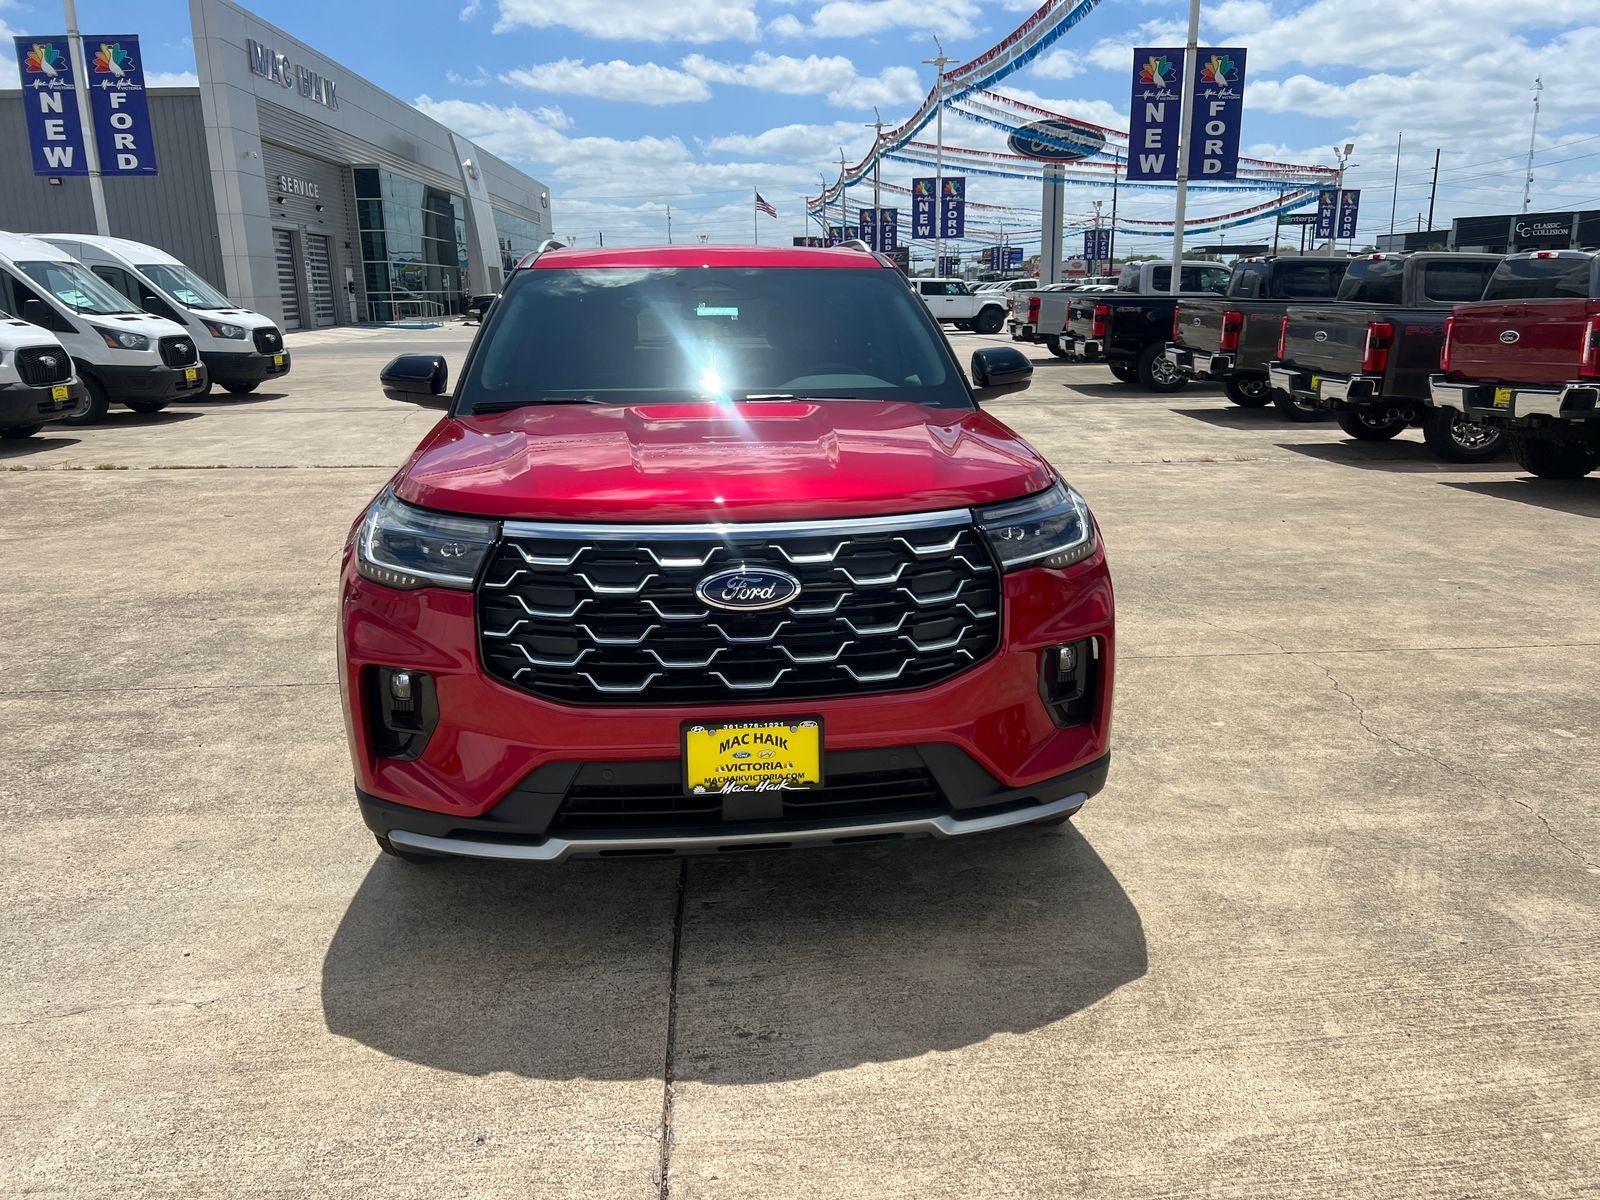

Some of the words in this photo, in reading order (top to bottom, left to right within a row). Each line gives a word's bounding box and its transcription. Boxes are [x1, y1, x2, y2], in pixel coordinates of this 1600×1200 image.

[247, 38, 292, 89] MAC
[295, 64, 339, 112] HAIK
[40, 92, 73, 168] NEW
[110, 92, 139, 170] FORD
[1139, 102, 1166, 174] NEW
[1203, 101, 1226, 174] FORD
[280, 175, 320, 198] SERVICE
[917, 201, 930, 236] NEW
[947, 201, 958, 236] FORD
[1320, 209, 1331, 237] NEW
[1342, 209, 1352, 237] FORD
[884, 225, 893, 251] FORD
[721, 576, 777, 600] Ford
[719, 733, 750, 754] MAC
[753, 732, 788, 751] HAIK
[704, 772, 805, 784] MACHAIKVICTORIA.COM
[725, 762, 784, 772] VICTORIA
[718, 780, 754, 795] Mac
[754, 778, 797, 793] Haik
